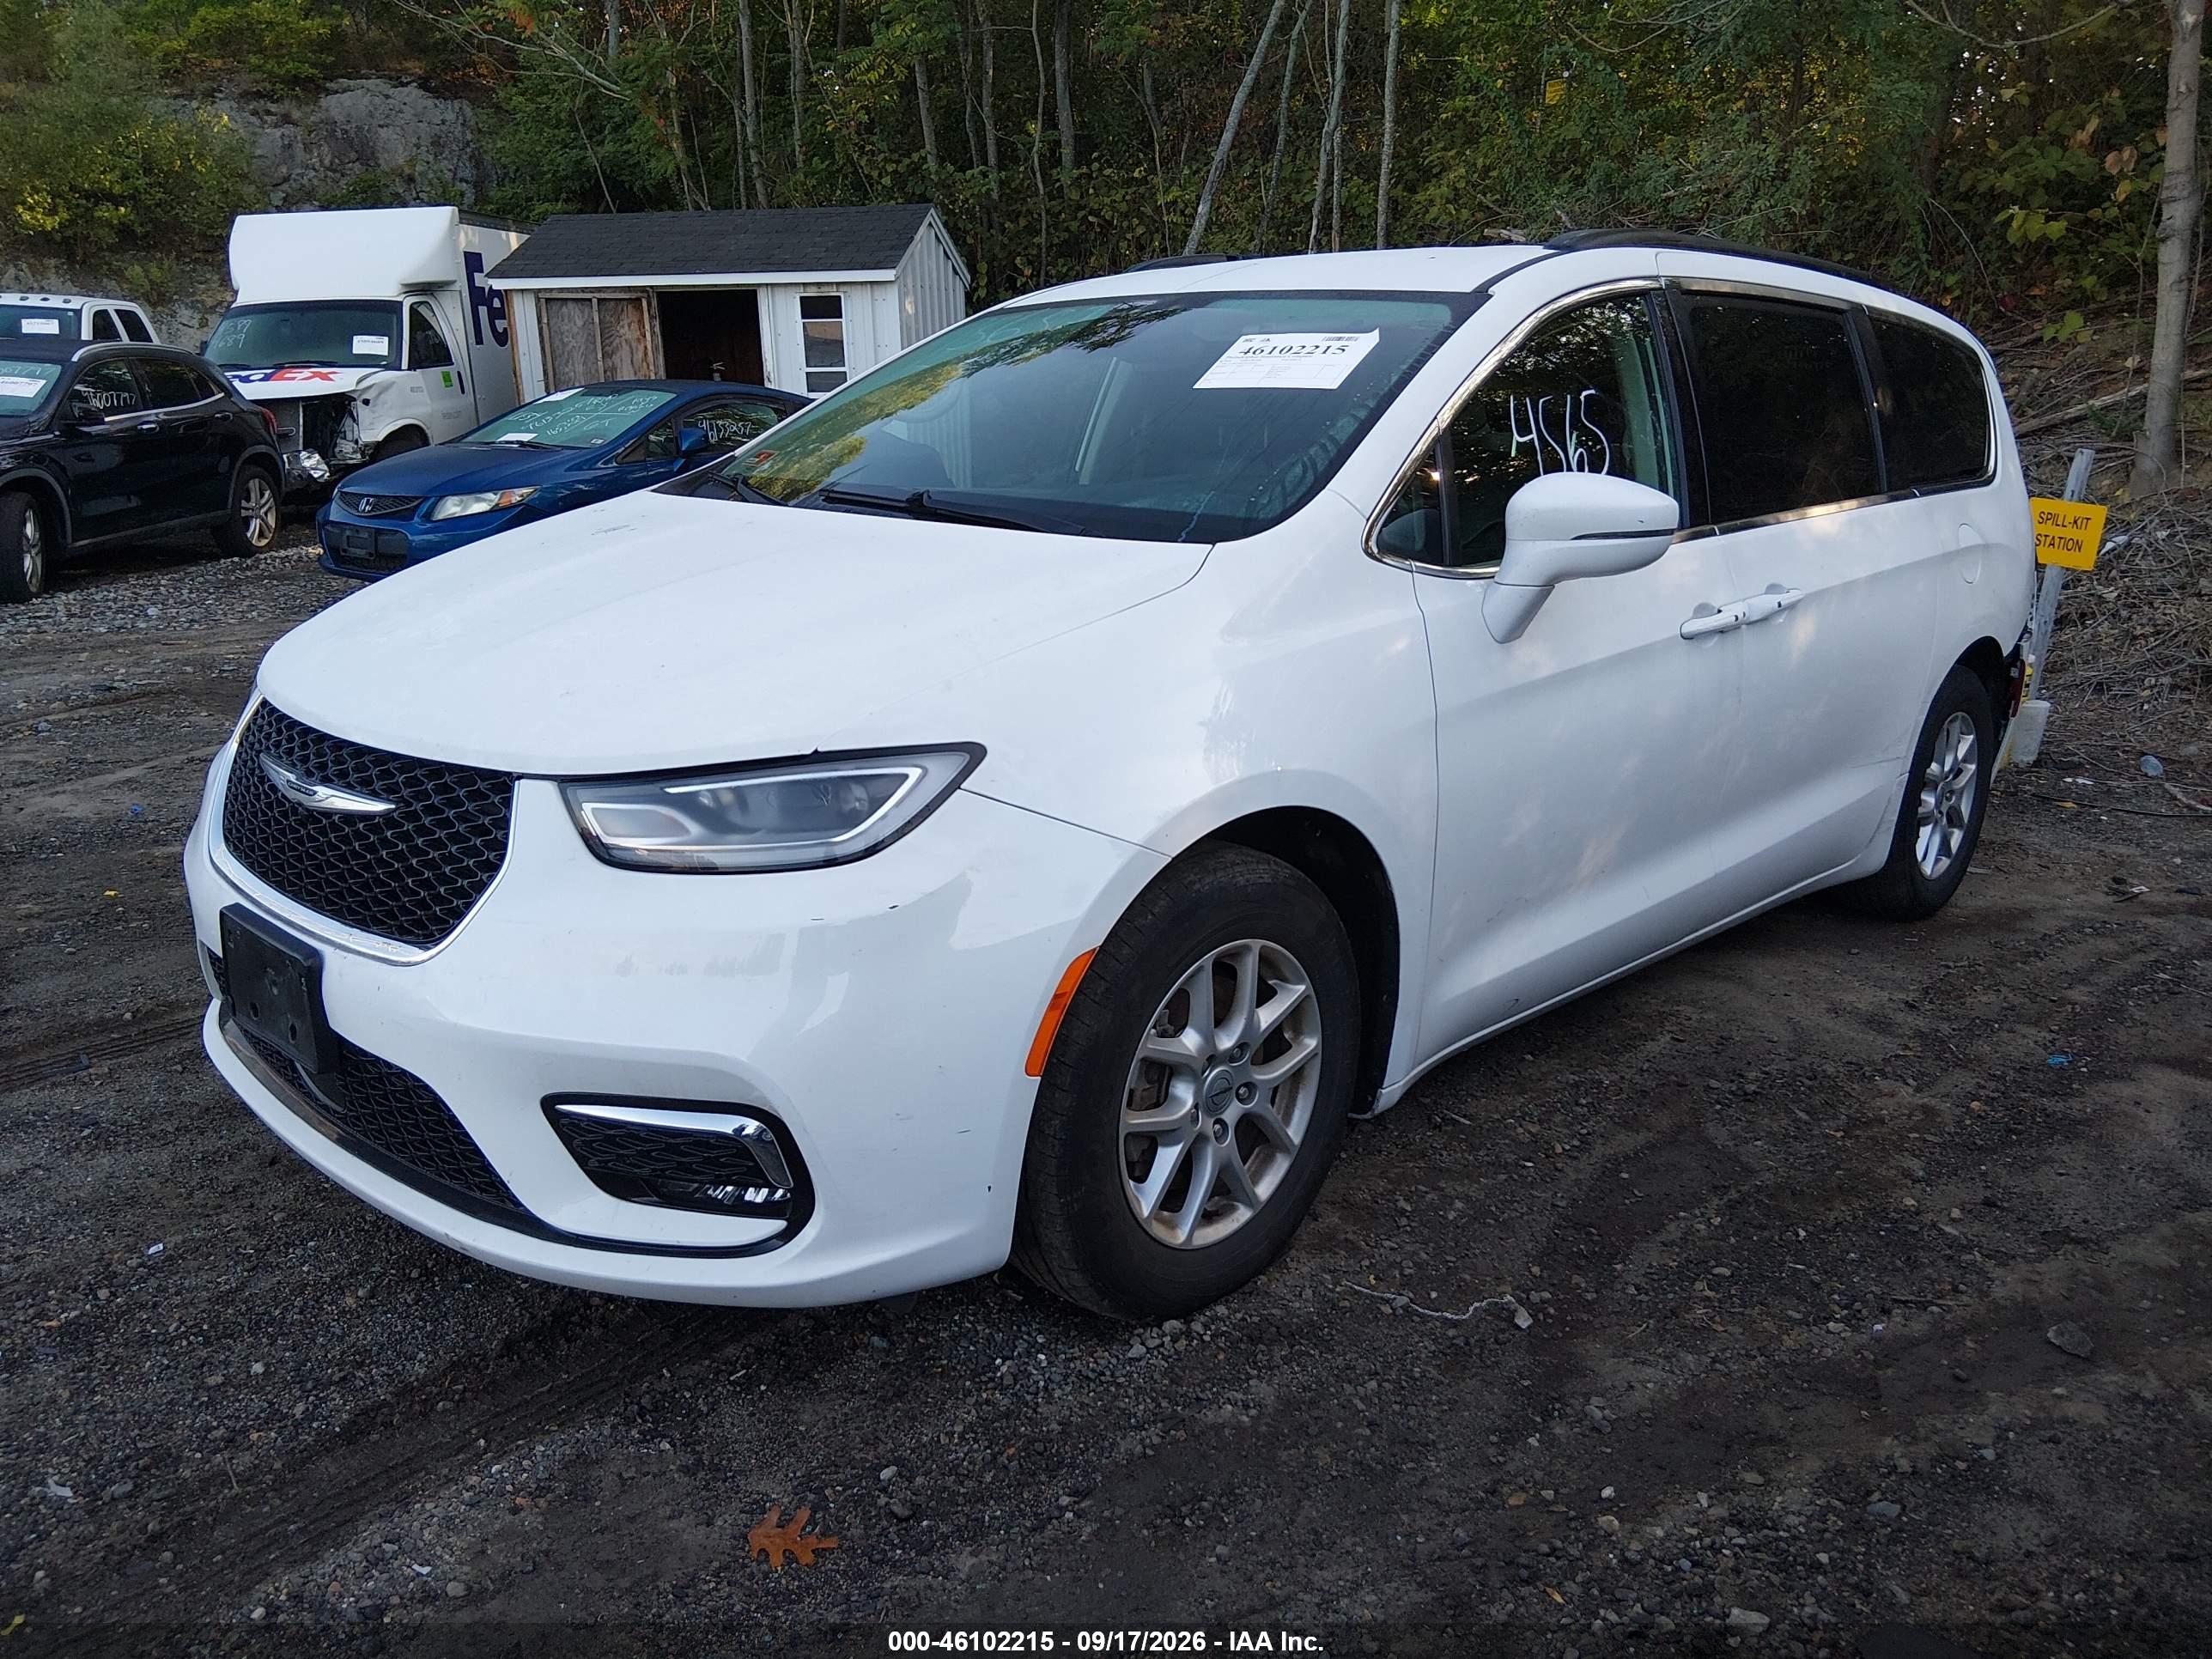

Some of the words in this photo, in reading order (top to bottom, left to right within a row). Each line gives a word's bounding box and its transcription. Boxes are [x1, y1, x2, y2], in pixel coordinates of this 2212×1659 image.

[1239, 344, 1350, 356] 46102215
[698, 418, 752, 441] 46133257
[1510, 389, 1610, 476] 4565
[2038, 511, 2091, 531] SPILL-KIT
[2035, 532, 2083, 552] STATION
